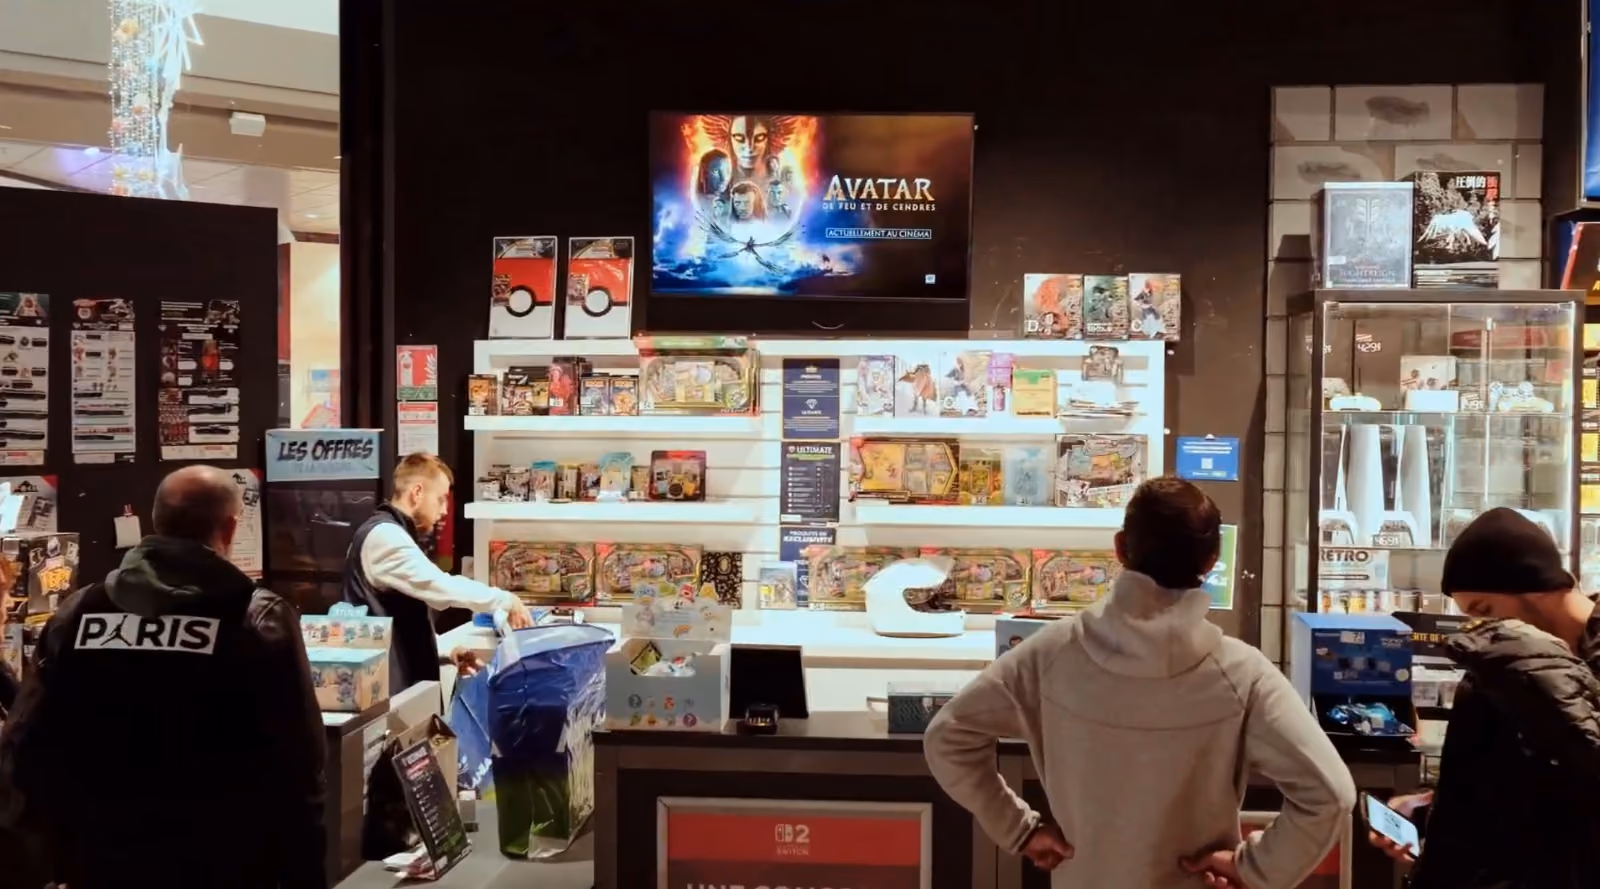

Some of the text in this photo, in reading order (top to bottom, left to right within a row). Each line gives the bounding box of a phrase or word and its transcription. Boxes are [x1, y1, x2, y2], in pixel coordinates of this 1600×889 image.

[822, 174, 936, 201] AVATAR
[822, 202, 937, 212] DE FEU ET DE CENDRES
[828, 229, 930, 239] ACTUELLEMENT AU CINÉMA
[277, 438, 374, 462] LES OFFRES
[796, 445, 833, 454] ULTIMATE
